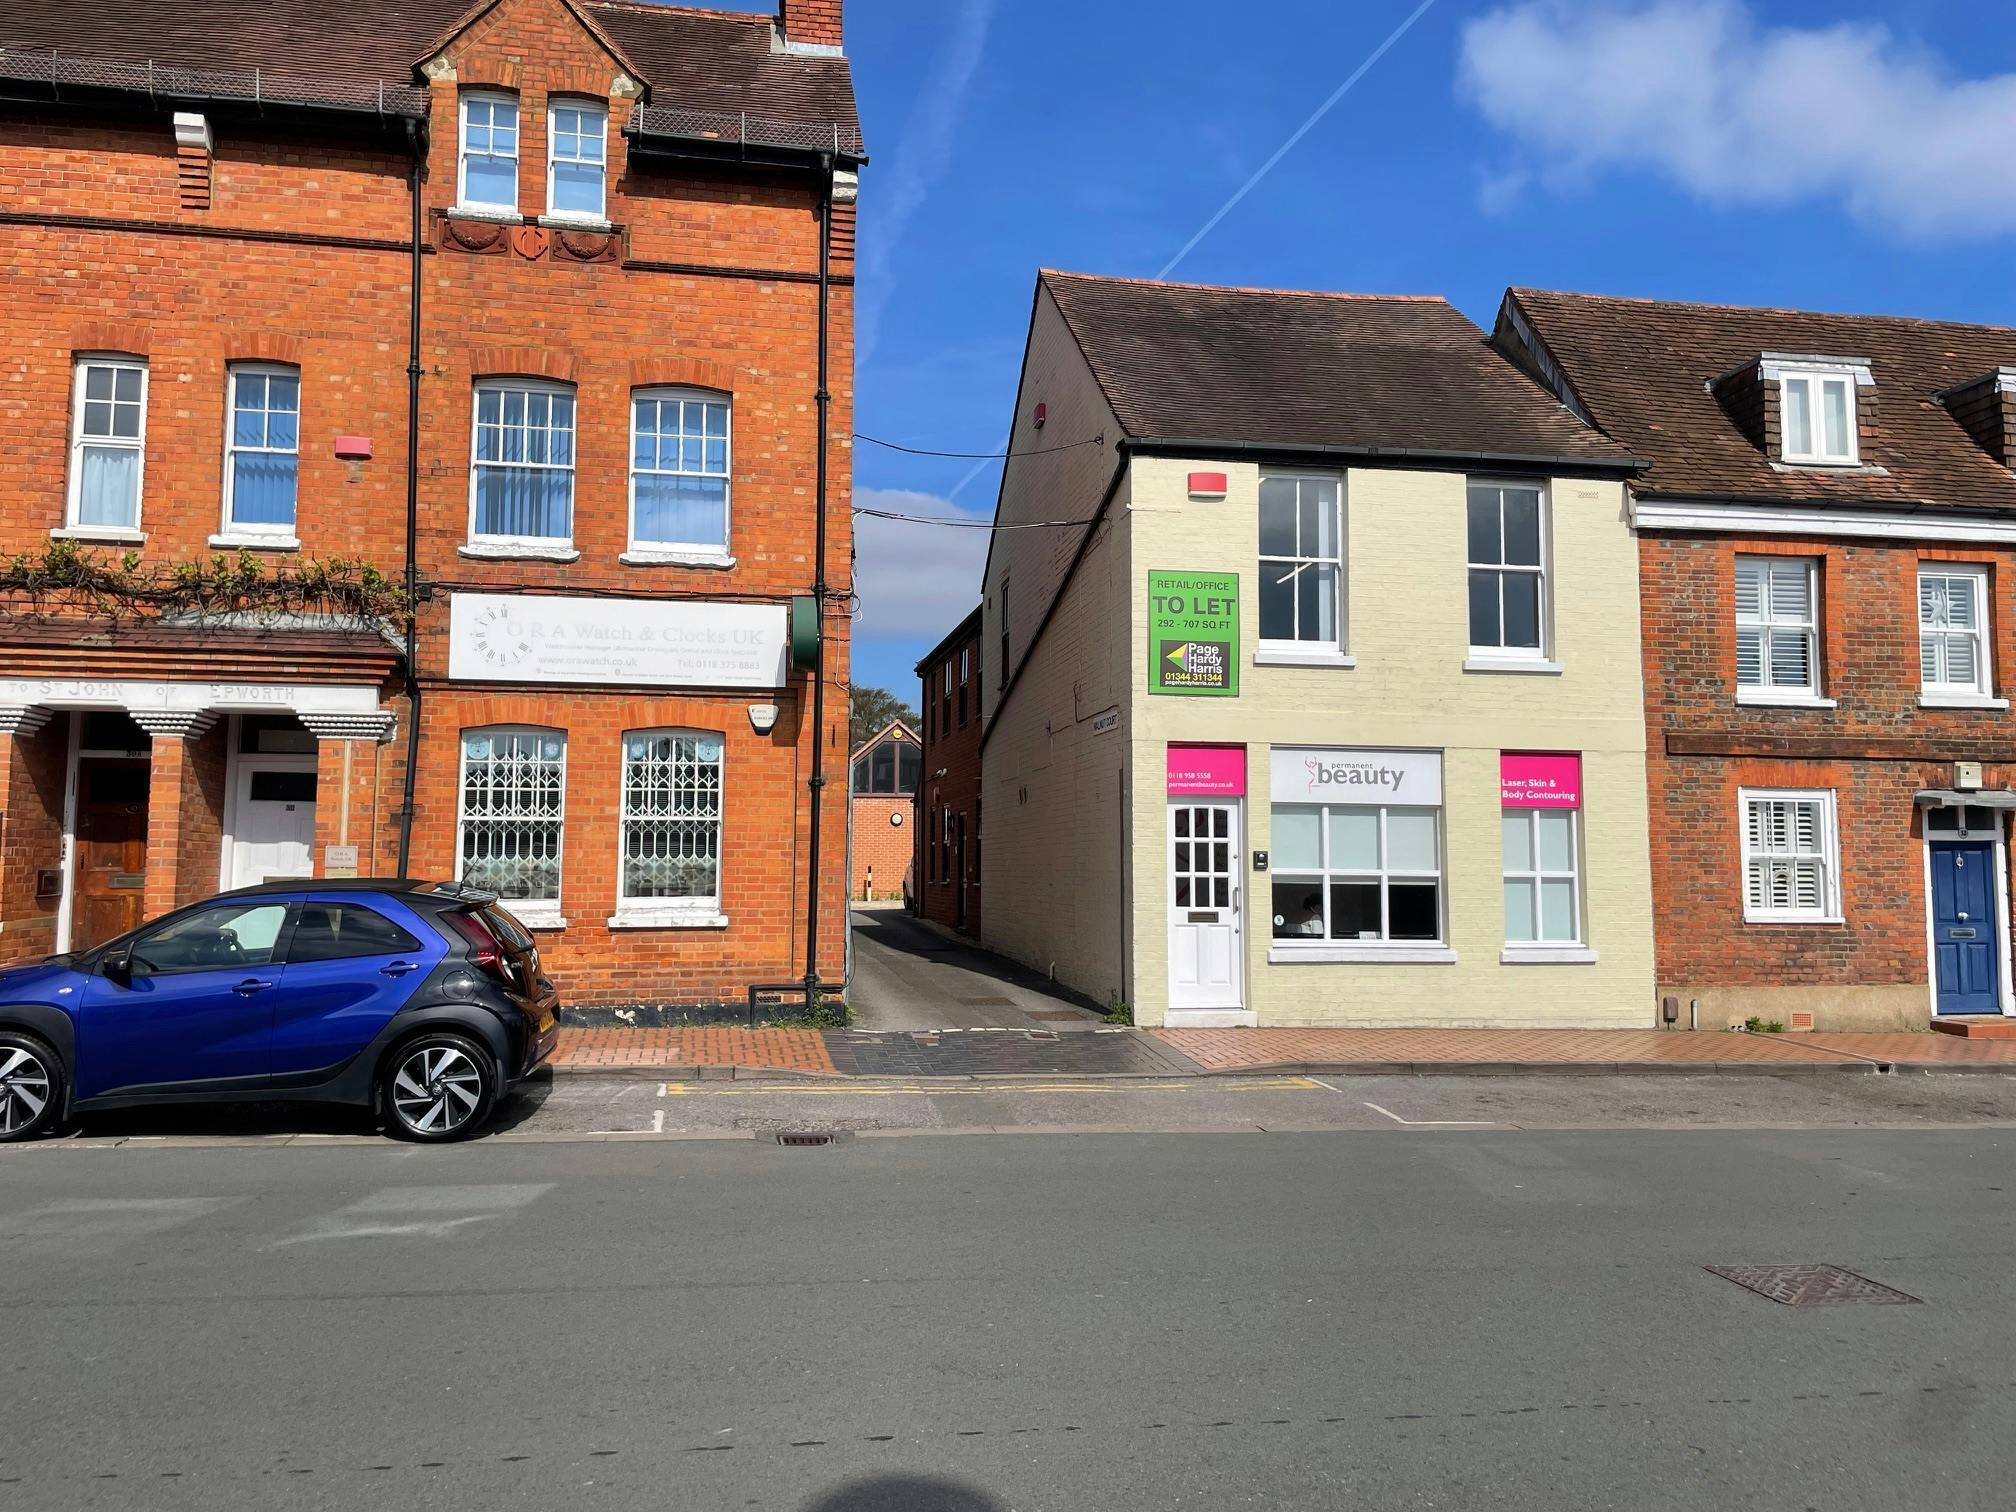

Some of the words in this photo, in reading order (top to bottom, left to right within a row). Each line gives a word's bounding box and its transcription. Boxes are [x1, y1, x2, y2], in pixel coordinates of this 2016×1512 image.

[1157, 580, 1229, 590] RETAIL/OFFICE
[1152, 596, 1185, 614] TO
[1193, 597, 1236, 616] LET
[1158, 620, 1174, 628] 292
[1183, 620, 1200, 629] 707
[1202, 620, 1217, 630] SQ
[1219, 621, 1231, 629] FT
[552, 623, 568, 639] A
[575, 624, 632, 641] Watch
[639, 625, 656, 641] &
[662, 626, 727, 644] Clocks
[729, 629, 765, 645] UK
[1188, 642, 1220, 656] Page
[537, 656, 638, 667] www.orawatch.co.uk
[1188, 653, 1223, 666] Hardy
[1188, 663, 1223, 674] Harris
[1165, 672, 1191, 681] 01344
[1192, 673, 1223, 682] 311344
[68, 681, 124, 697] JOHN
[209, 684, 295, 701] EPWORTH
[1331, 760, 1374, 770] permanent
[1317, 762, 1405, 792] beauty
[1168, 781, 1234, 789] permanentbeauty.co.uk
[1502, 778, 1527, 788] Laser,
[1528, 778, 1547, 787] Skin
[1549, 779, 1556, 788] &
[1502, 790, 1524, 801] Body
[1526, 790, 1576, 801] Contouring
